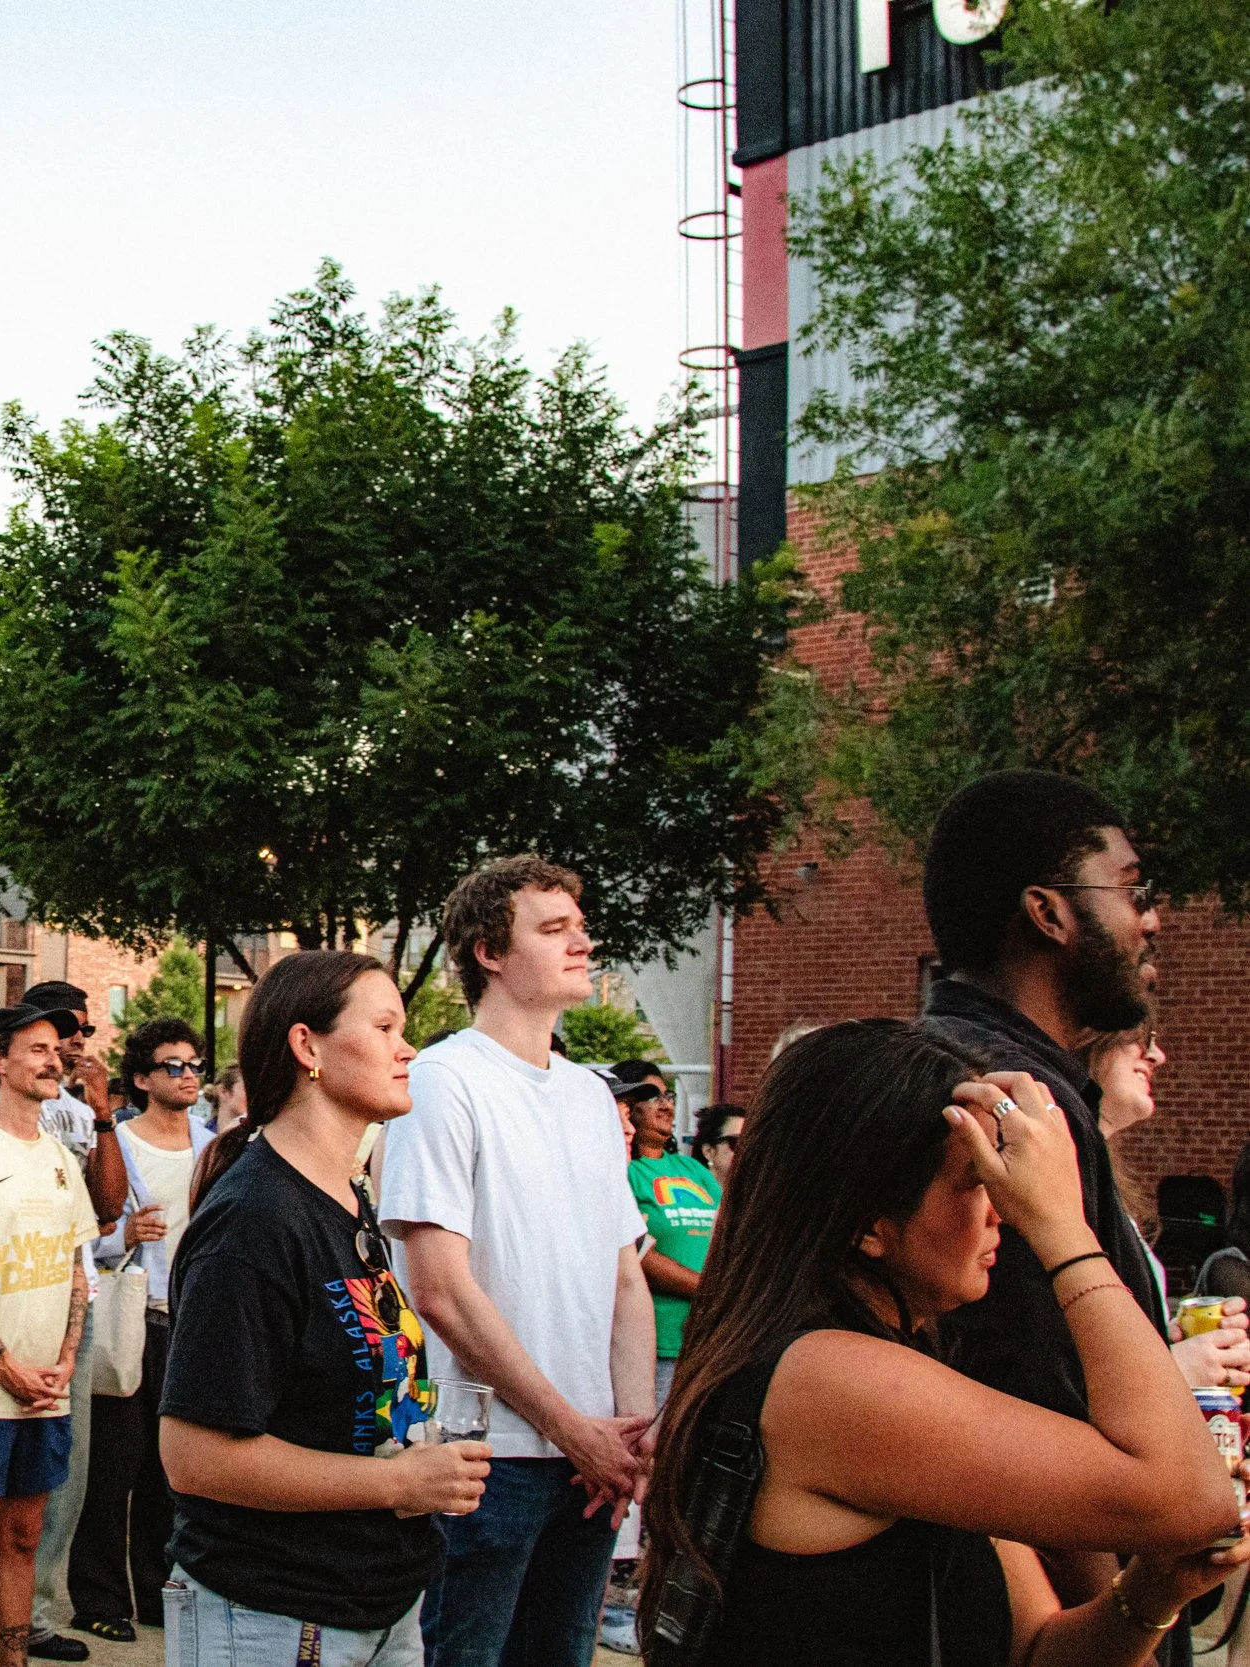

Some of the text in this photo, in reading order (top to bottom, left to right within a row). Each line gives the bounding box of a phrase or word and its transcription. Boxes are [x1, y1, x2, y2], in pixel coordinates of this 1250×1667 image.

[11, 1231, 62, 1264] Way
[0, 1257, 70, 1295] Dallas
[324, 1279, 375, 1453] ANKS ALASKA
